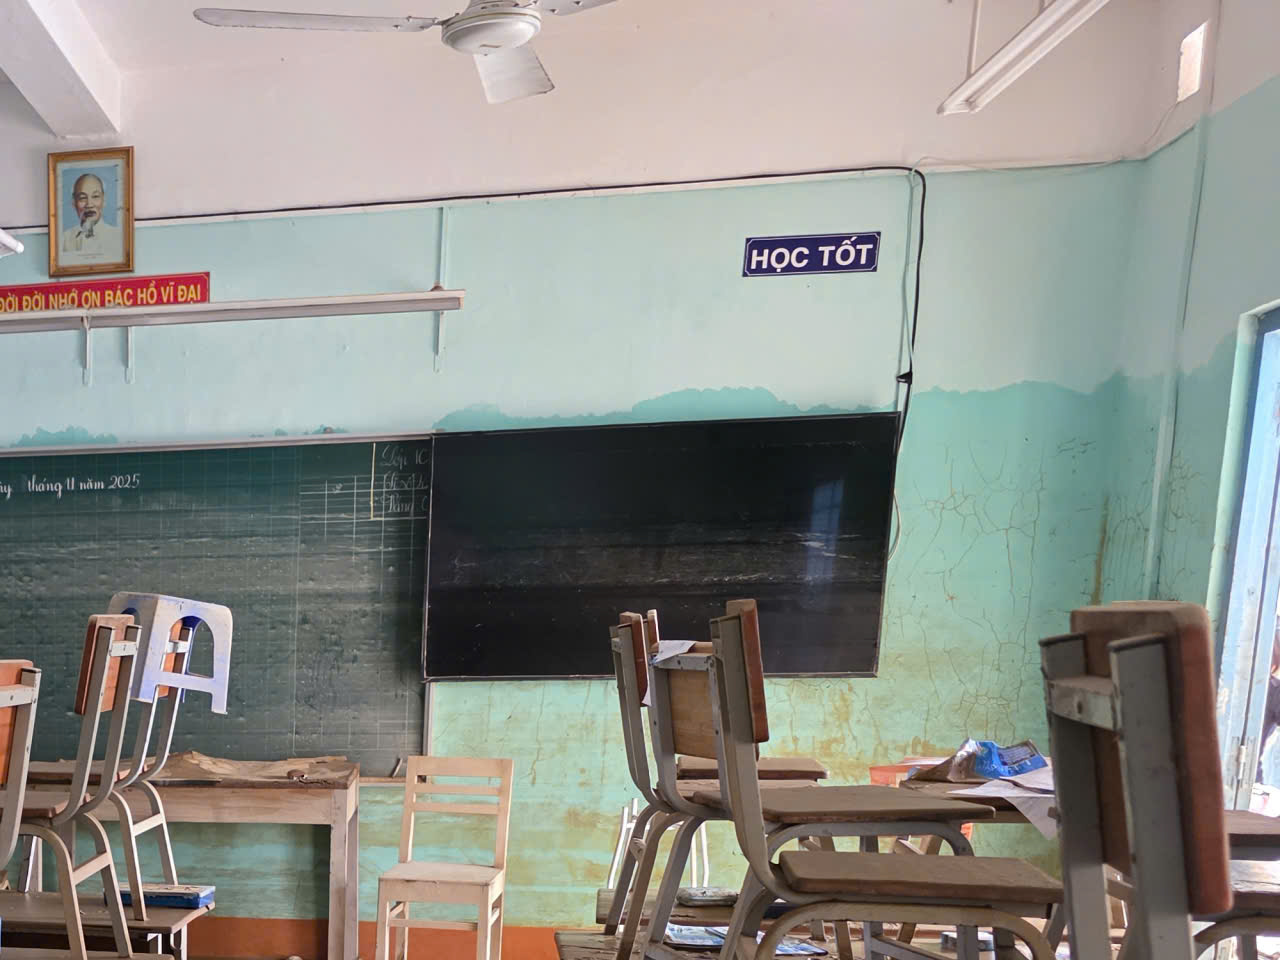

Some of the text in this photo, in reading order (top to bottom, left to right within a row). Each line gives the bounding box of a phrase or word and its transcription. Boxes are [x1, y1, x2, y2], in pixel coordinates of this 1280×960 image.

[750, 236, 874, 272] HỌC TỐT
[22, 290, 45, 312] ĐỜI
[49, 288, 78, 310] NHỚ
[81, 289, 101, 309] ƠN
[104, 285, 133, 307] BÁC
[137, 280, 158, 305] HỒ
[161, 281, 175, 303] VĨ
[177, 284, 201, 304] ĐẠI
[27, 474, 63, 499] tháng
[67, 477, 75, 491] 11
[79, 478, 105, 491] năm
[107, 473, 141, 489] 2025
